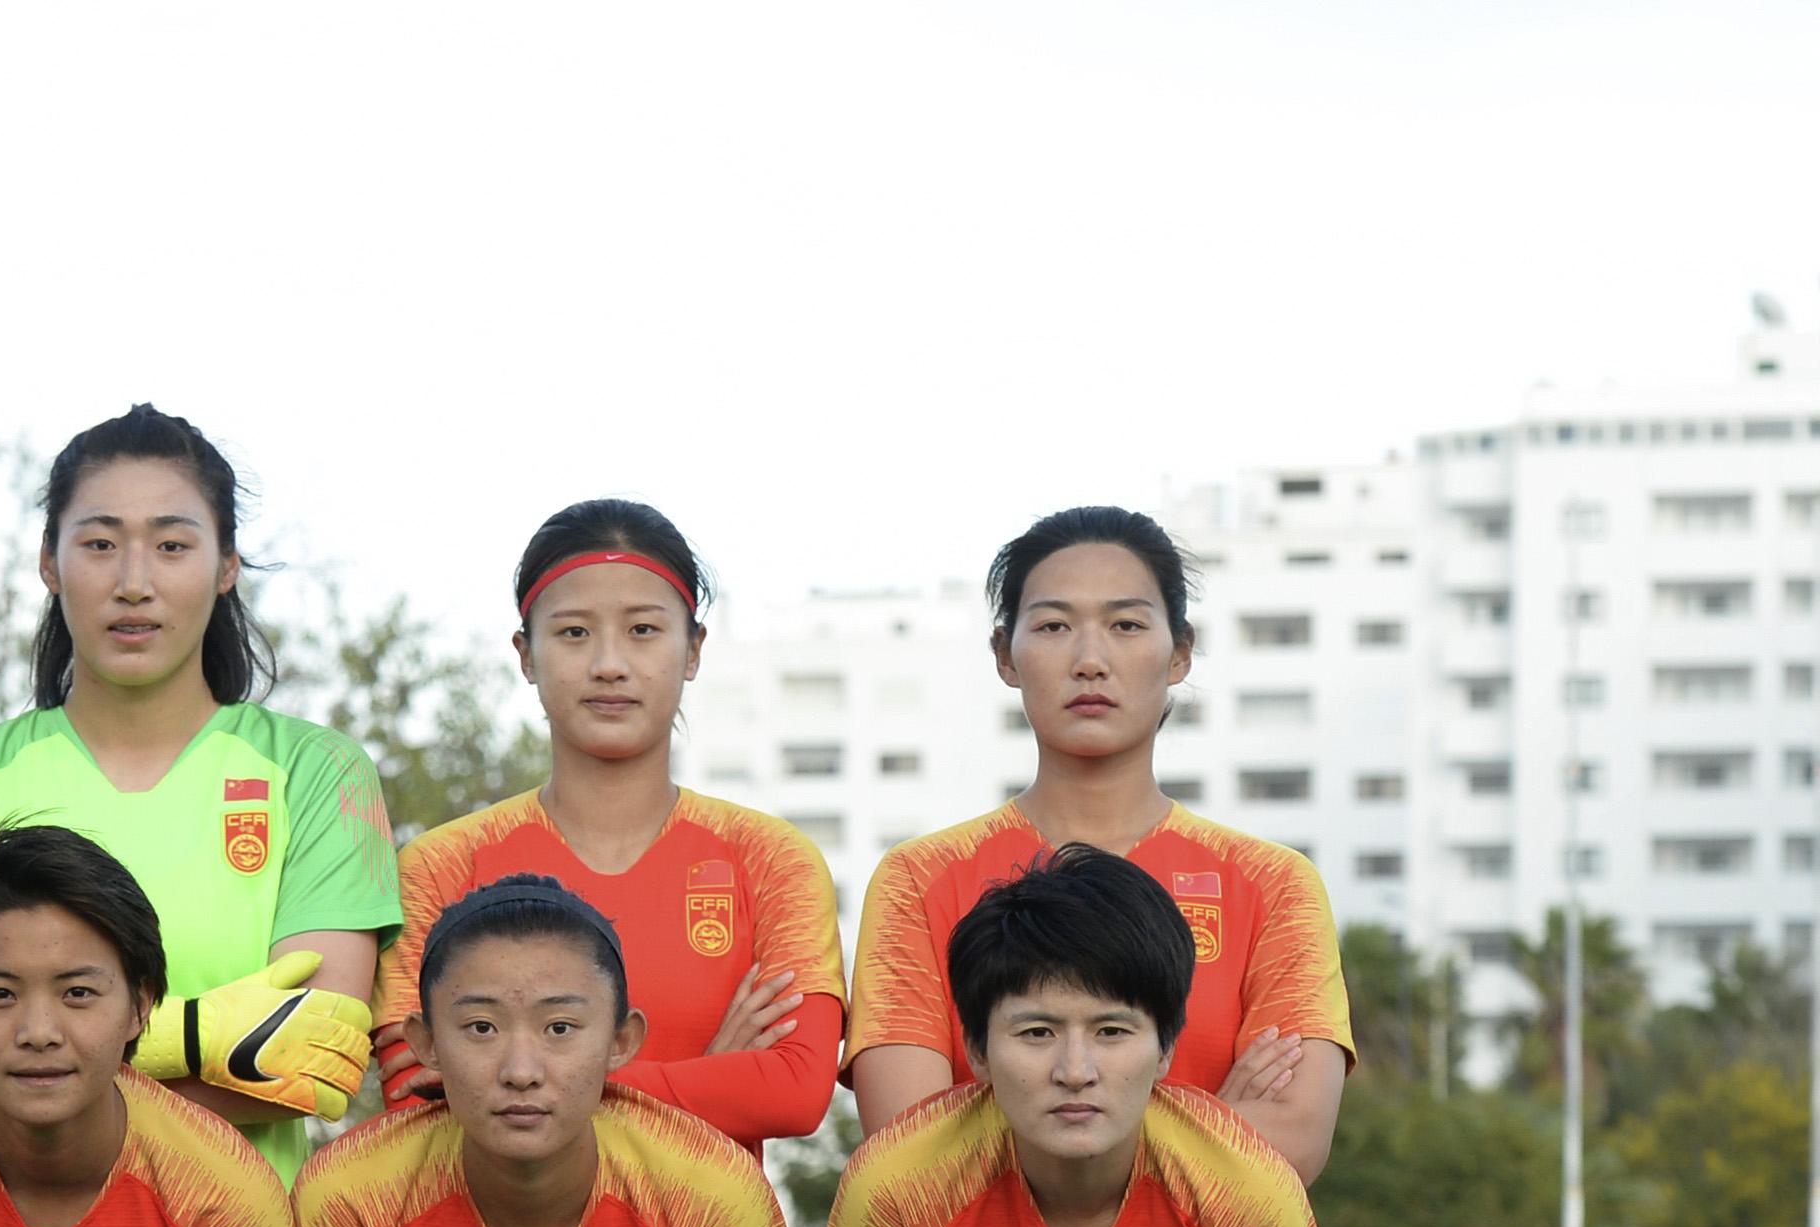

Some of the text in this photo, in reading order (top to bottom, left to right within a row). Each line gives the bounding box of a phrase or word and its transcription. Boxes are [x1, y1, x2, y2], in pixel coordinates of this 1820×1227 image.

[227, 815, 266, 827] CFA
[690, 899, 728, 911] CFA
[1180, 907, 1217, 921] CFA
